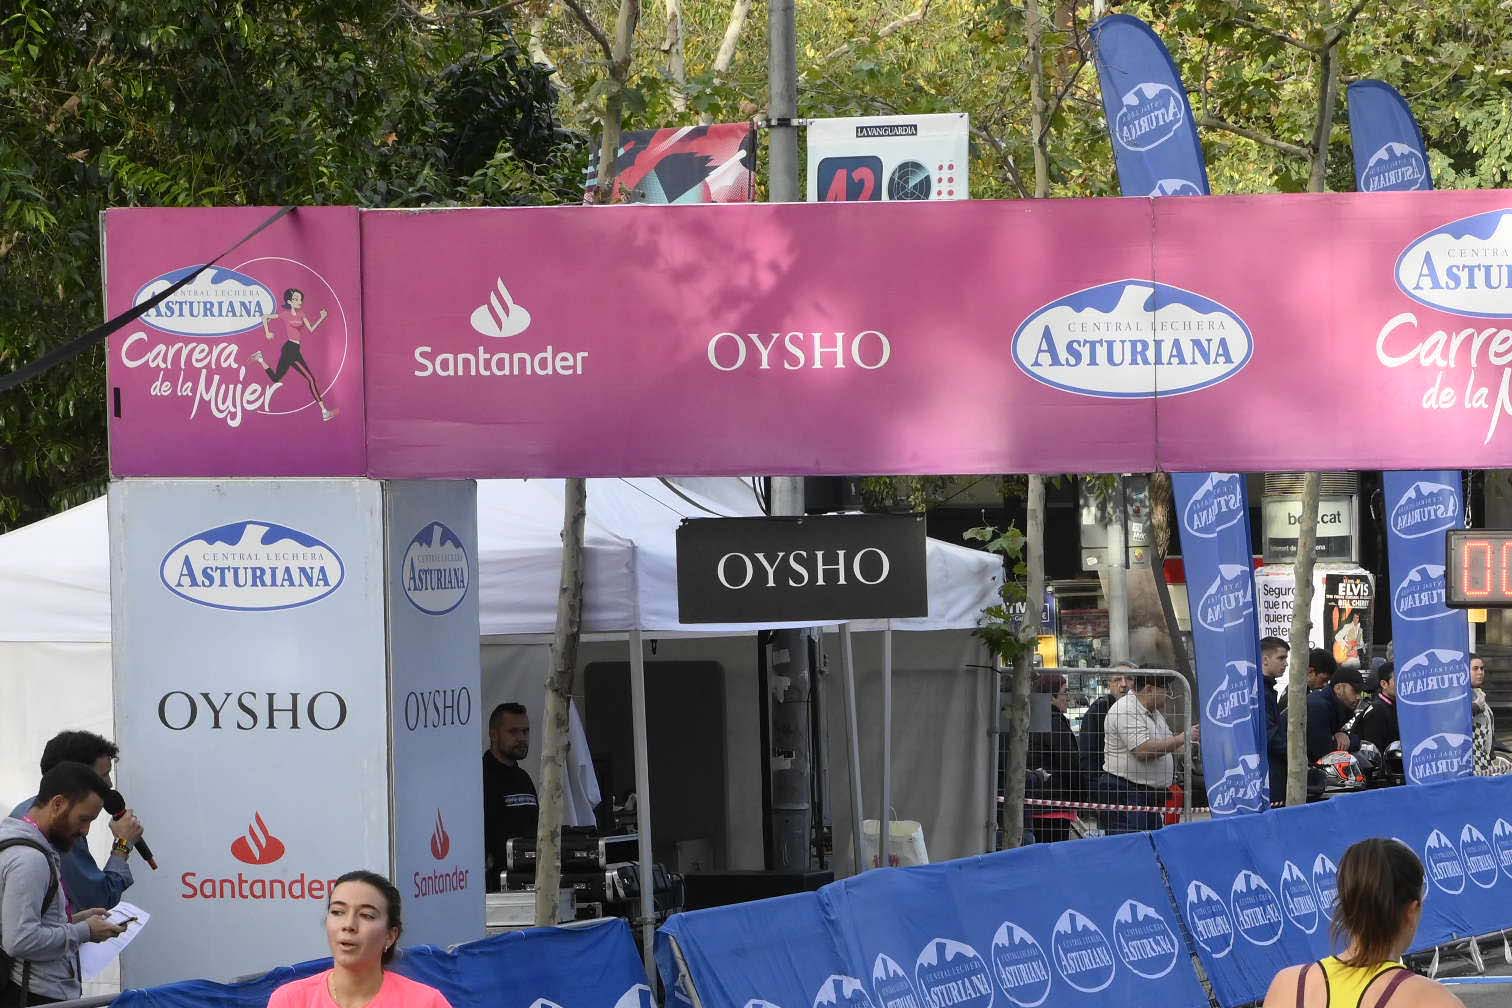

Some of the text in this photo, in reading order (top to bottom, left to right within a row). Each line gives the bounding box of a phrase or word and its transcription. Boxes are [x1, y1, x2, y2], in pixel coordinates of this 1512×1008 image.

[1067, 320, 1227, 333] CENTRAL LECHERA
[121, 331, 239, 369] Carrera
[414, 345, 589, 377] Santander
[707, 330, 891, 371] OYSHO
[1031, 324, 1234, 368] ASTURIANA
[150, 369, 193, 397] de la
[190, 366, 283, 428] Mujer
[1422, 368, 1488, 410] de la
[174, 554, 331, 588] ASTURIANA
[203, 551, 325, 561] CENTRAL LECHERA
[716, 547, 890, 590] OYSHO
[407, 557, 465, 592] ASTURIANA
[1338, 583, 1369, 596] ELVIS
[1264, 600, 1280, 611] que
[1264, 613, 1292, 623] quiere
[157, 690, 347, 732] OYSHO
[405, 687, 472, 732] OYSHO
[181, 872, 335, 900] Santander
[413, 865, 469, 899] Santander
[997, 957, 1048, 989] ASTURIANA
[1058, 944, 1112, 975] ASTURIANA
